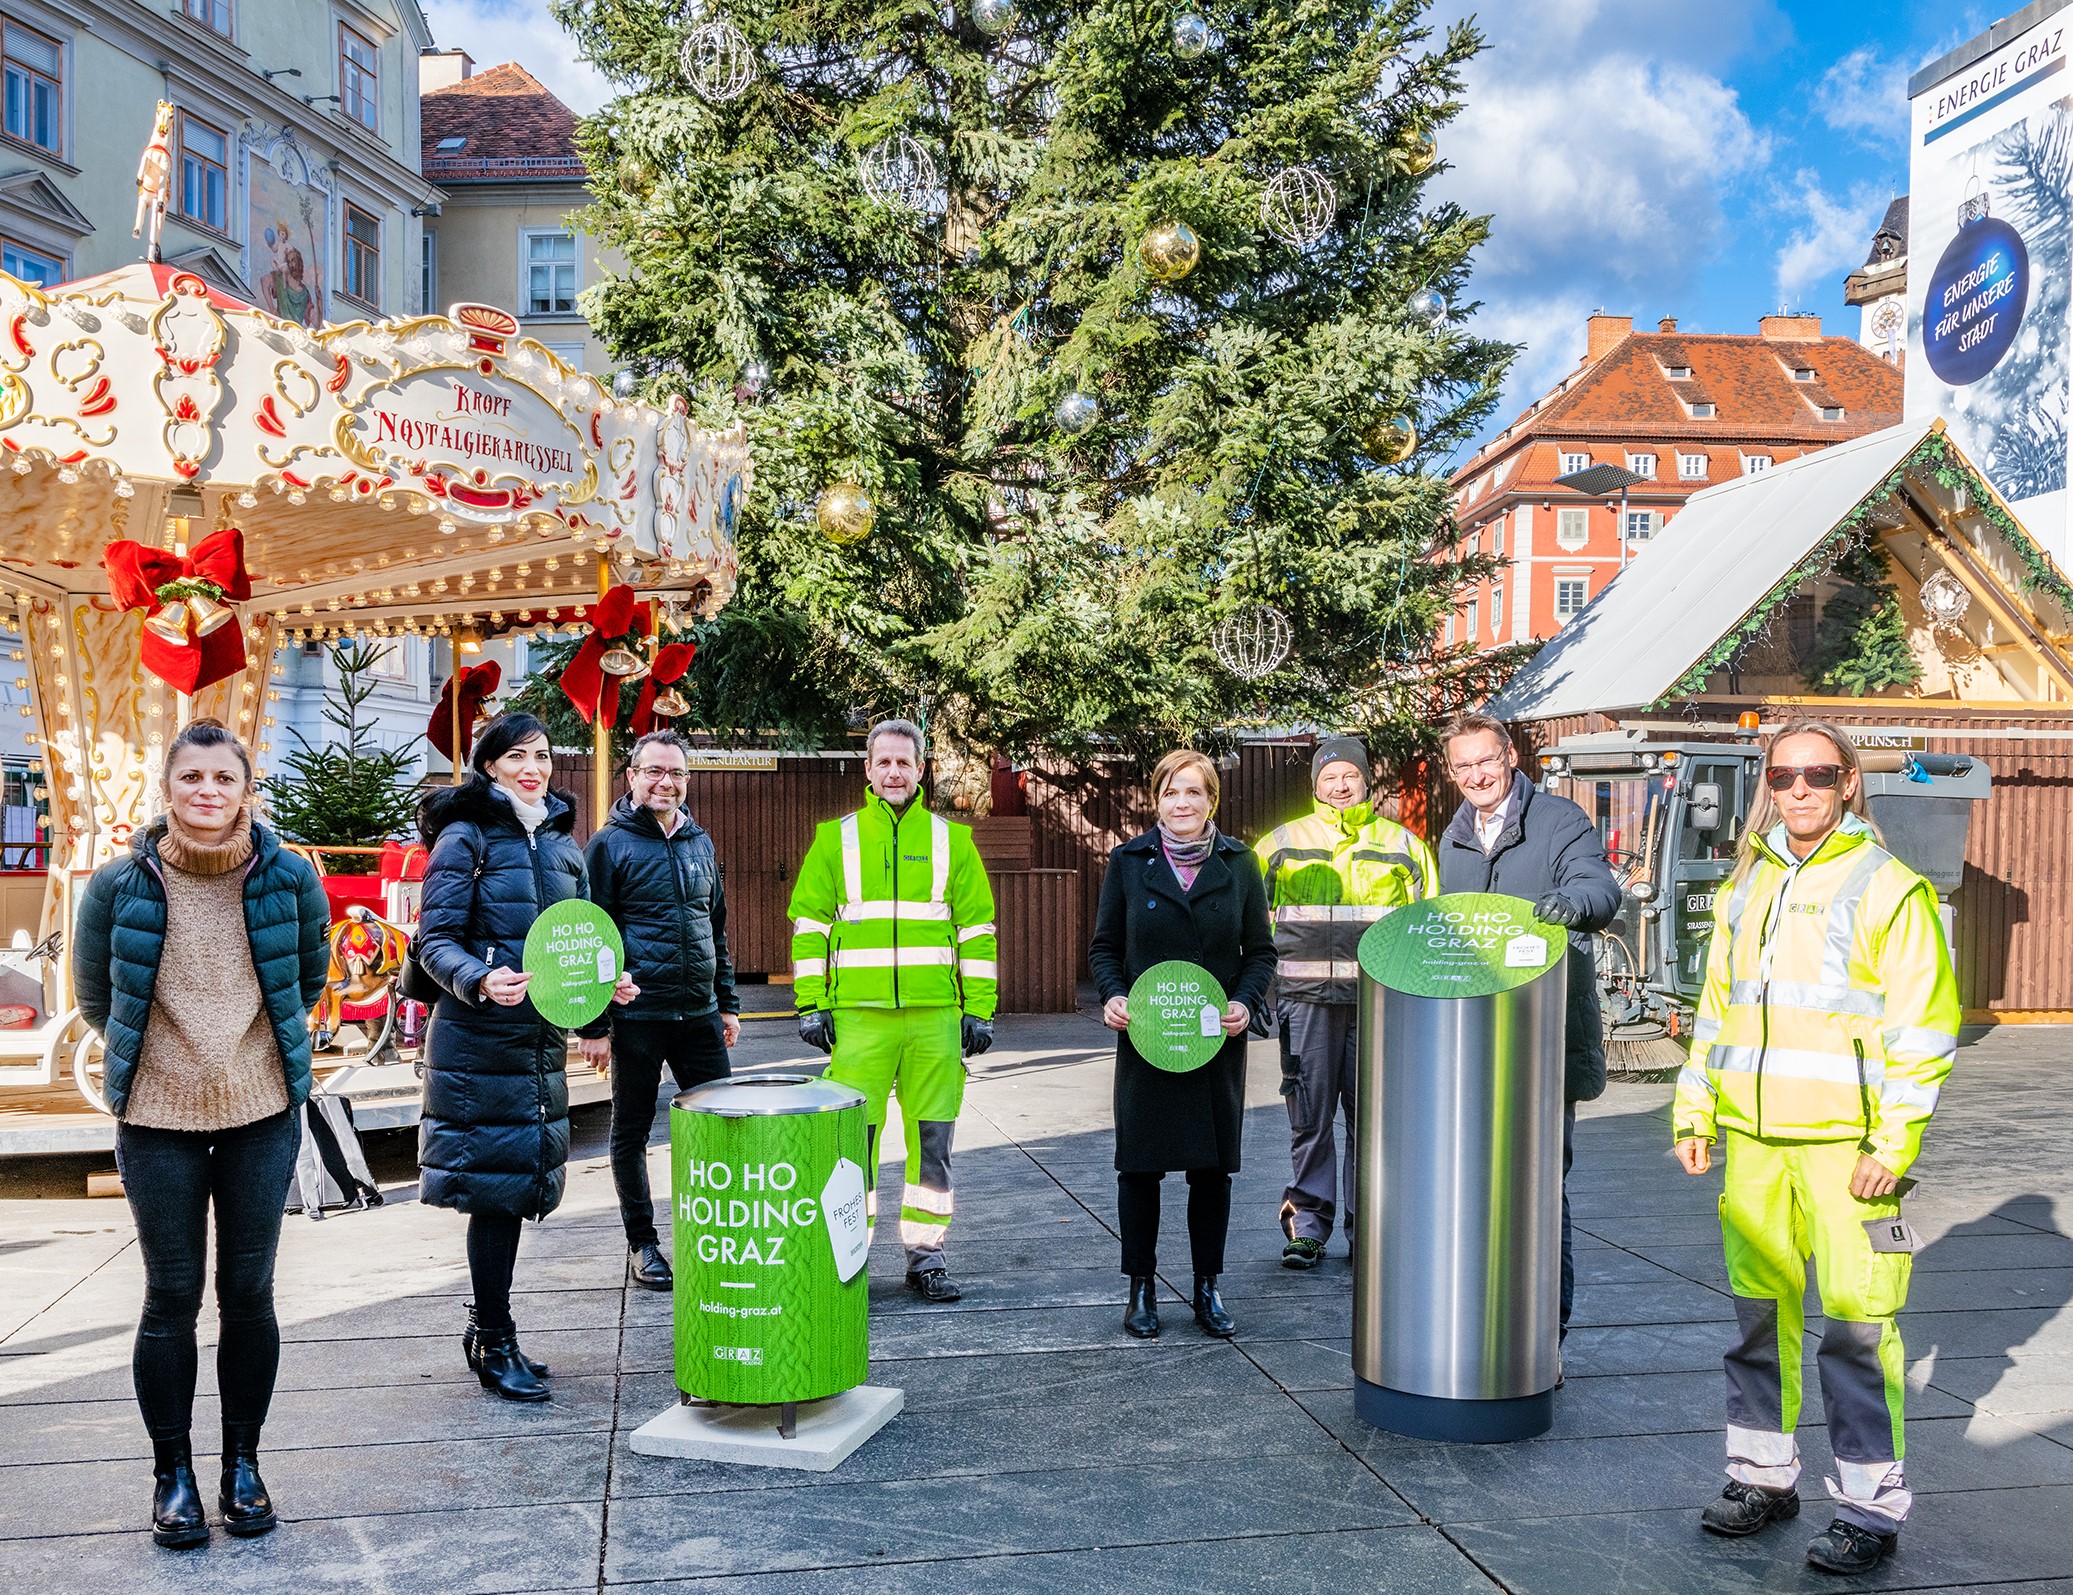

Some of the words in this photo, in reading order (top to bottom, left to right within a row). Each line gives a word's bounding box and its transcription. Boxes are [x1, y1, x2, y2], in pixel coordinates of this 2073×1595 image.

[1937, 61, 2007, 119] ENERGIE
[2014, 28, 2064, 74] GRAZ
[1943, 252, 2000, 308] ENERGIE
[1934, 310, 1960, 341] FÜR
[1962, 271, 2015, 322] UNSERE
[1959, 312, 1999, 352] STADT
[1427, 912, 1465, 923] HO
[1473, 912, 1512, 923] HO
[1789, 904, 1825, 914] GRAZ
[552, 924, 572, 937] HO
[575, 921, 595, 935] HO
[1407, 924, 1524, 936] HOLDING
[546, 936, 603, 954] HOLDING
[1427, 937, 1499, 949] GRAZ
[559, 952, 593, 967] GRAZ
[1422, 959, 1489, 967] holding-graz.at
[1157, 982, 1177, 993] HO
[1180, 982, 1200, 993] HO
[1149, 995, 1208, 1006] HOLDING
[1161, 1008, 1196, 1019] GRAZ
[689, 1159, 732, 1190] HO
[743, 1162, 797, 1191] HO
[679, 1193, 817, 1228] HOLDING
[832, 1191, 863, 1220] FROHES
[843, 1208, 859, 1229] FEST
[697, 1234, 785, 1265] GRAZ
[700, 1299, 782, 1319] holding-graz.at
[714, 1346, 764, 1360] GRAZ
